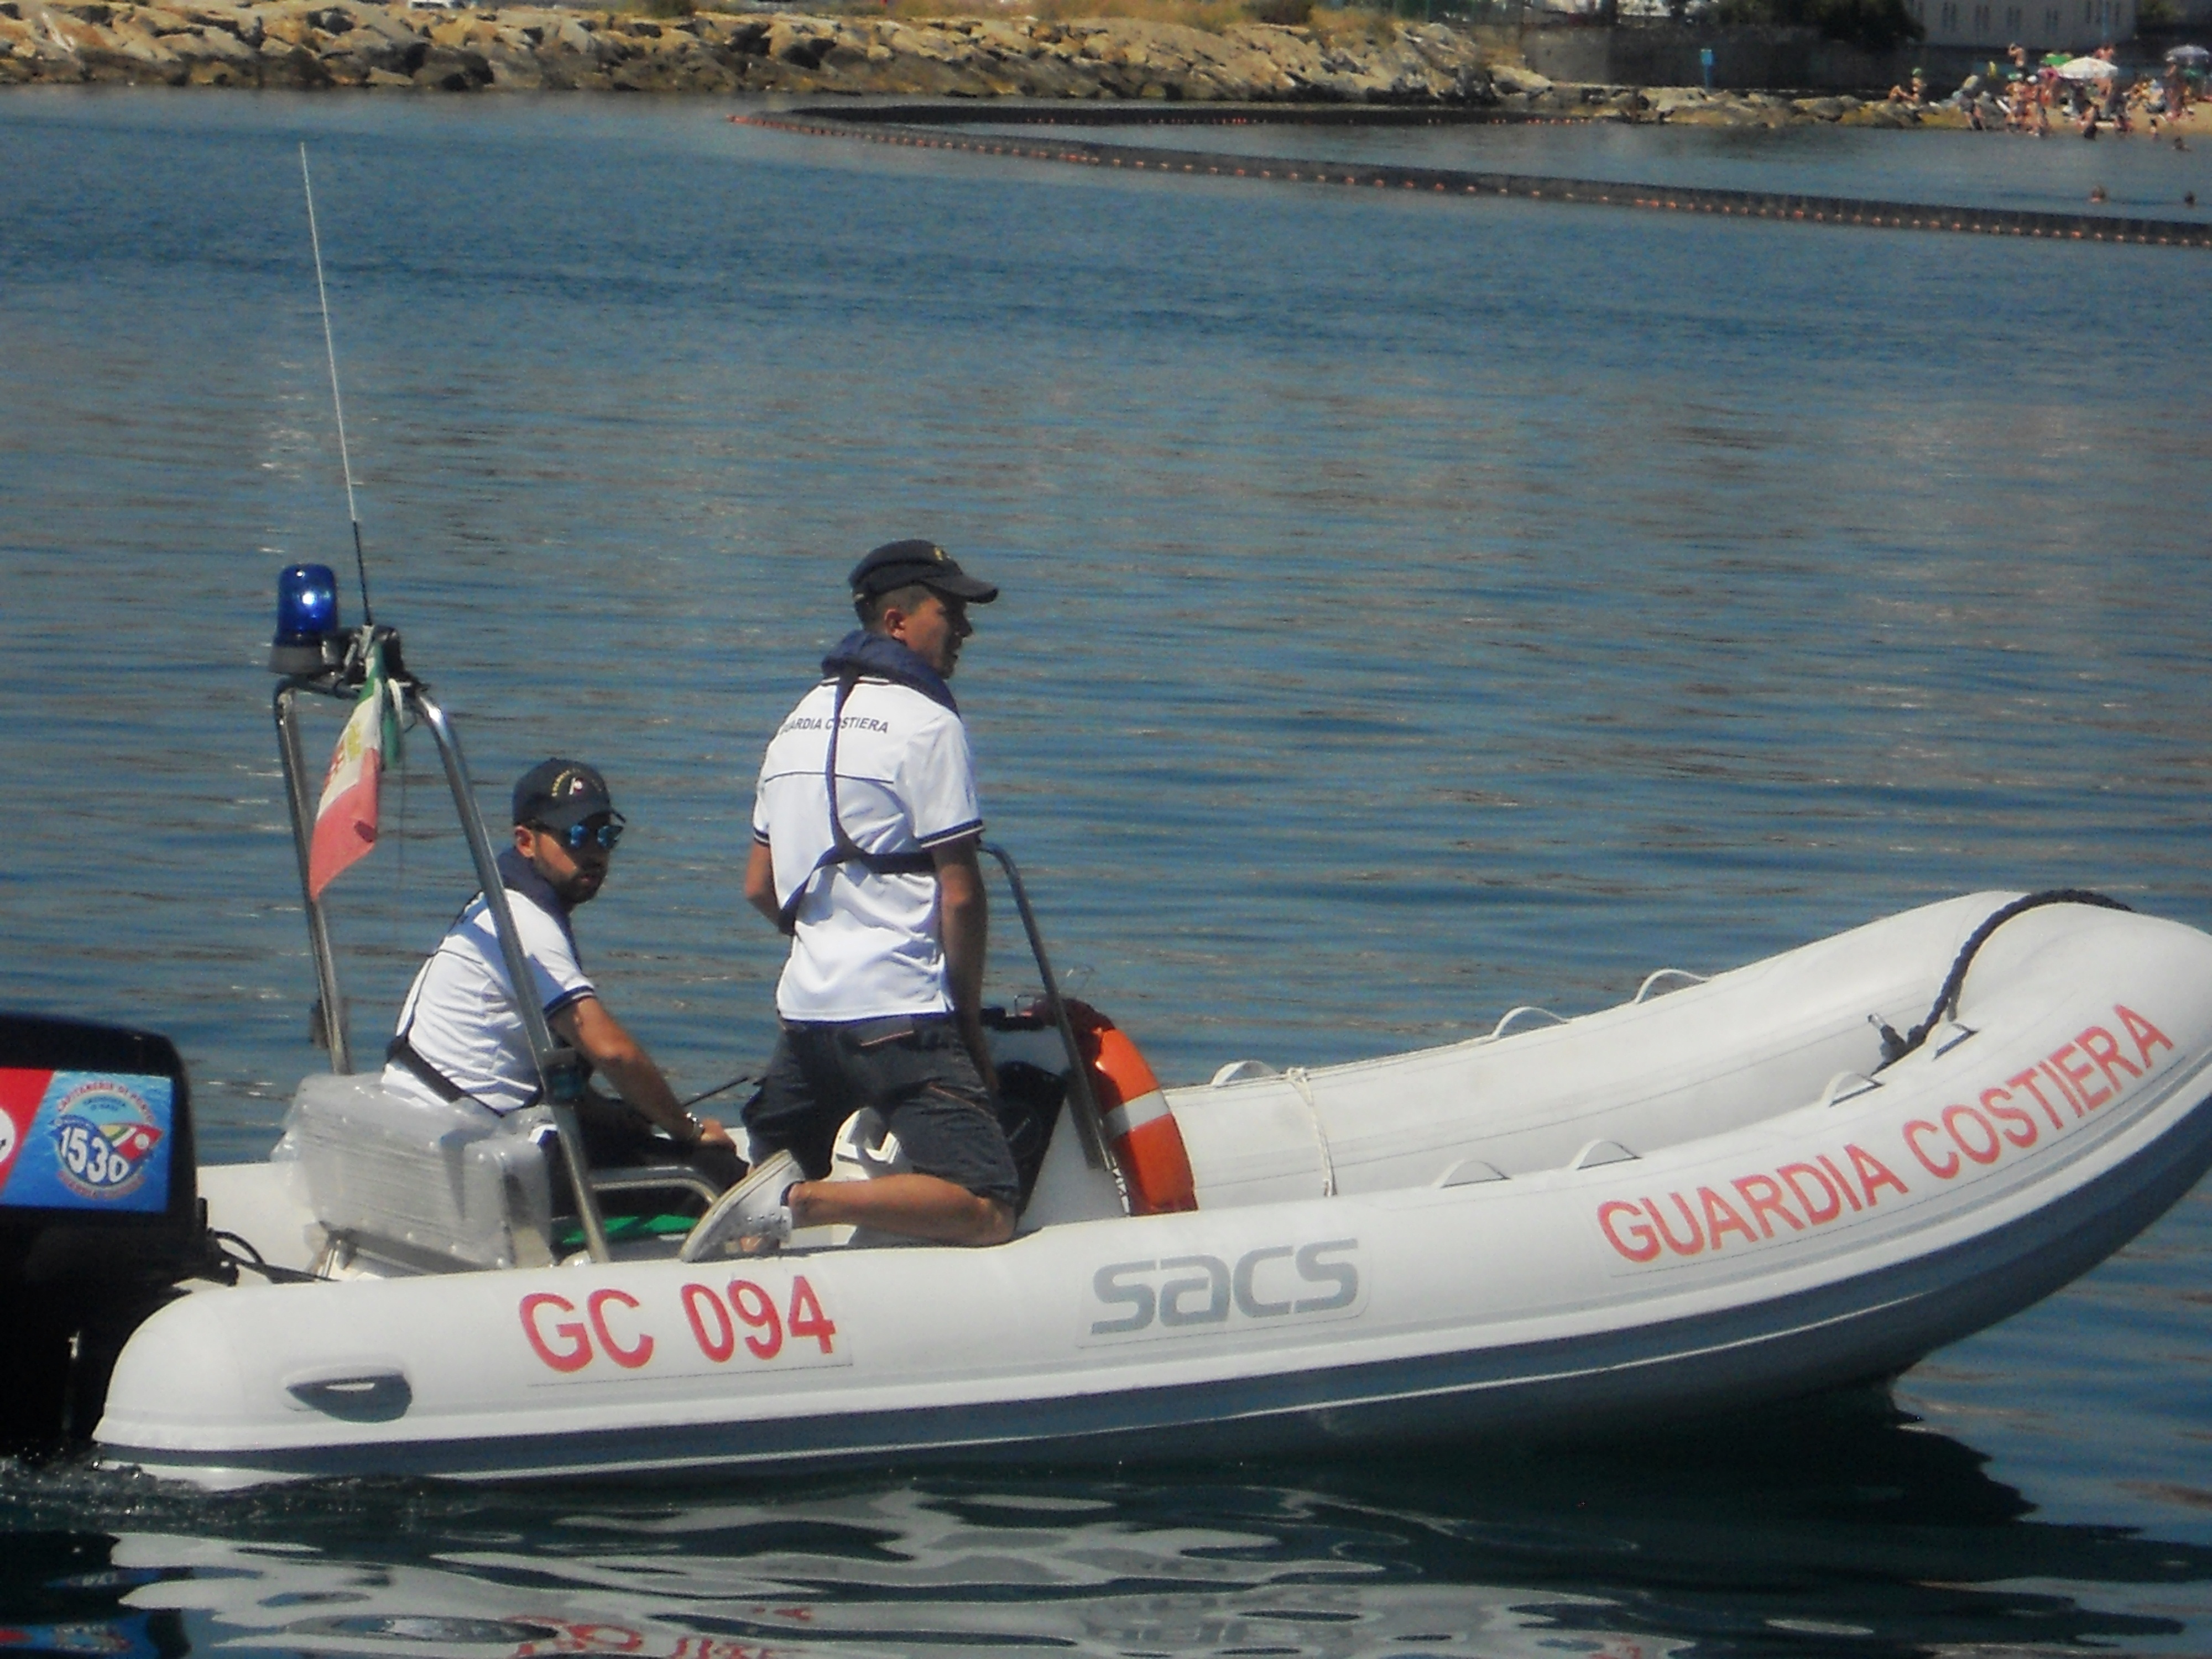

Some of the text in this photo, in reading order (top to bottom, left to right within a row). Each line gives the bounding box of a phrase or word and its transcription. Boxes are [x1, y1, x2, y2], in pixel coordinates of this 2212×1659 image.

[826, 717, 889, 733] CSTIERA
[61, 1126, 129, 1183] 1530
[1598, 1004, 2174, 1263] GUARDIA COSTIERA
[519, 1275, 837, 1373] GC 094
